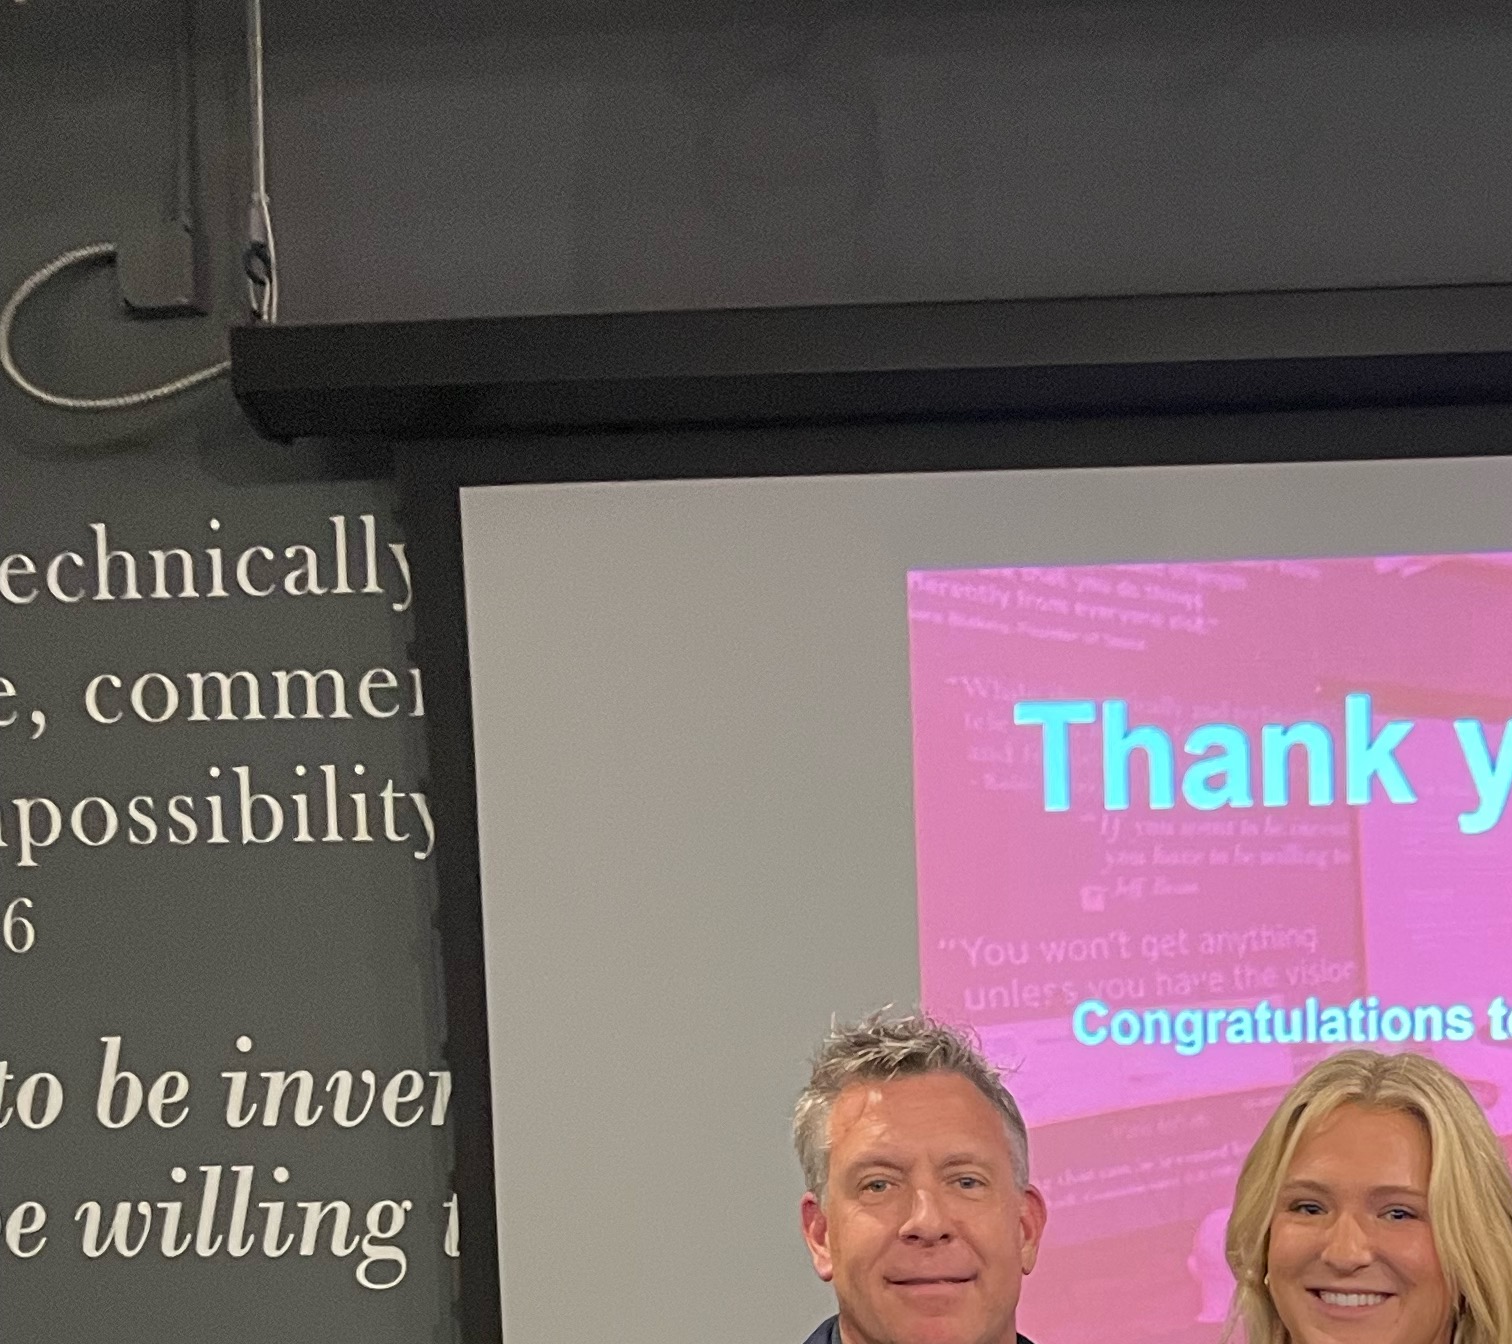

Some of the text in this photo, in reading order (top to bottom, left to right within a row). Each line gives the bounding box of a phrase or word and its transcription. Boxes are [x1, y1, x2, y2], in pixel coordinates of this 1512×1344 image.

[1013, 692, 1418, 812] Thank
[0, 764, 435, 867] possibility
[1072, 995, 1475, 1056] Congratulations
[96, 1035, 190, 1129] be
[74, 1164, 413, 1290] willing
